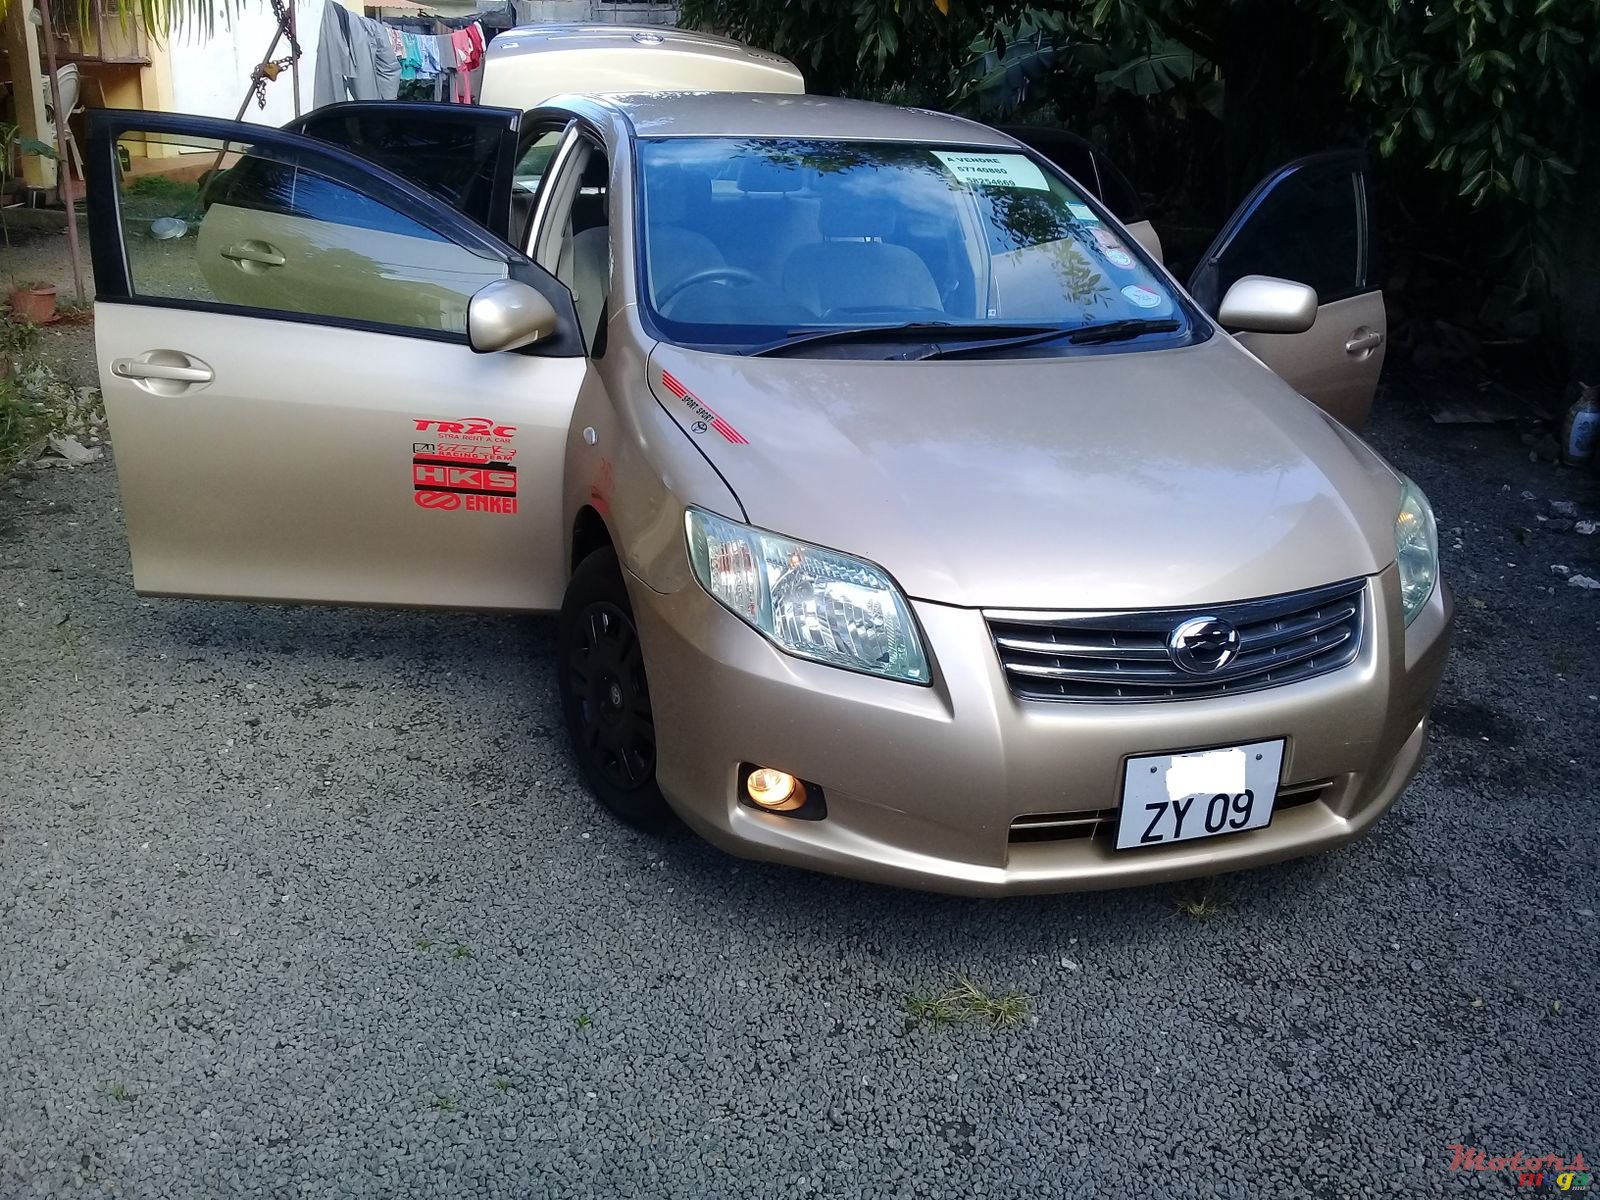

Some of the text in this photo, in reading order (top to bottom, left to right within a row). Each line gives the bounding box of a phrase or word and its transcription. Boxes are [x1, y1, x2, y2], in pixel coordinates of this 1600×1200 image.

[682, 395, 714, 423] SPORT SPORT
[439, 451, 479, 459] RACING
[416, 466, 515, 488] HKS
[466, 495, 518, 514] ENKEI
[1140, 789, 1255, 844] ZY 09
